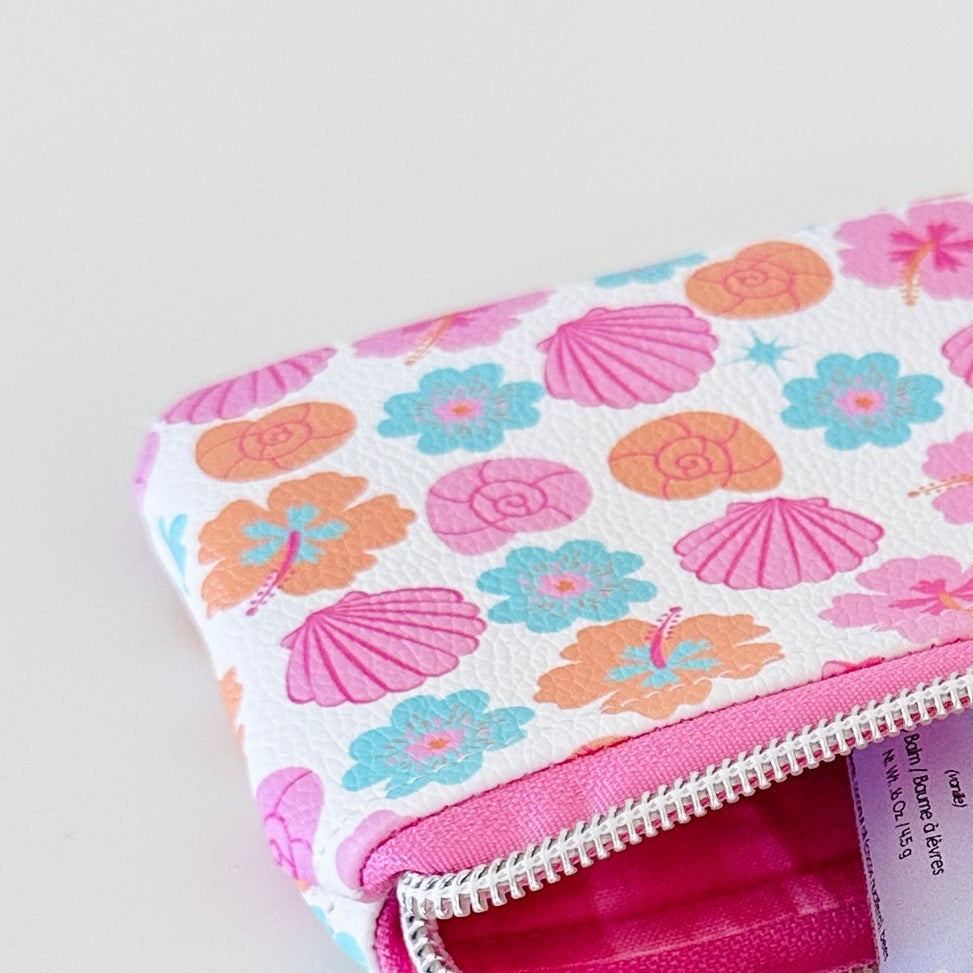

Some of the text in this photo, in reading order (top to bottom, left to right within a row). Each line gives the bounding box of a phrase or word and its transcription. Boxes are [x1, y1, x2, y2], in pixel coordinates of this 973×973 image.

[903, 733, 922, 767] Balm
[892, 800, 907, 822] Oz
[912, 774, 933, 820] Baume
[923, 822, 940, 833] à
[899, 848, 912, 860] g
[926, 831, 945, 876] lèvres
